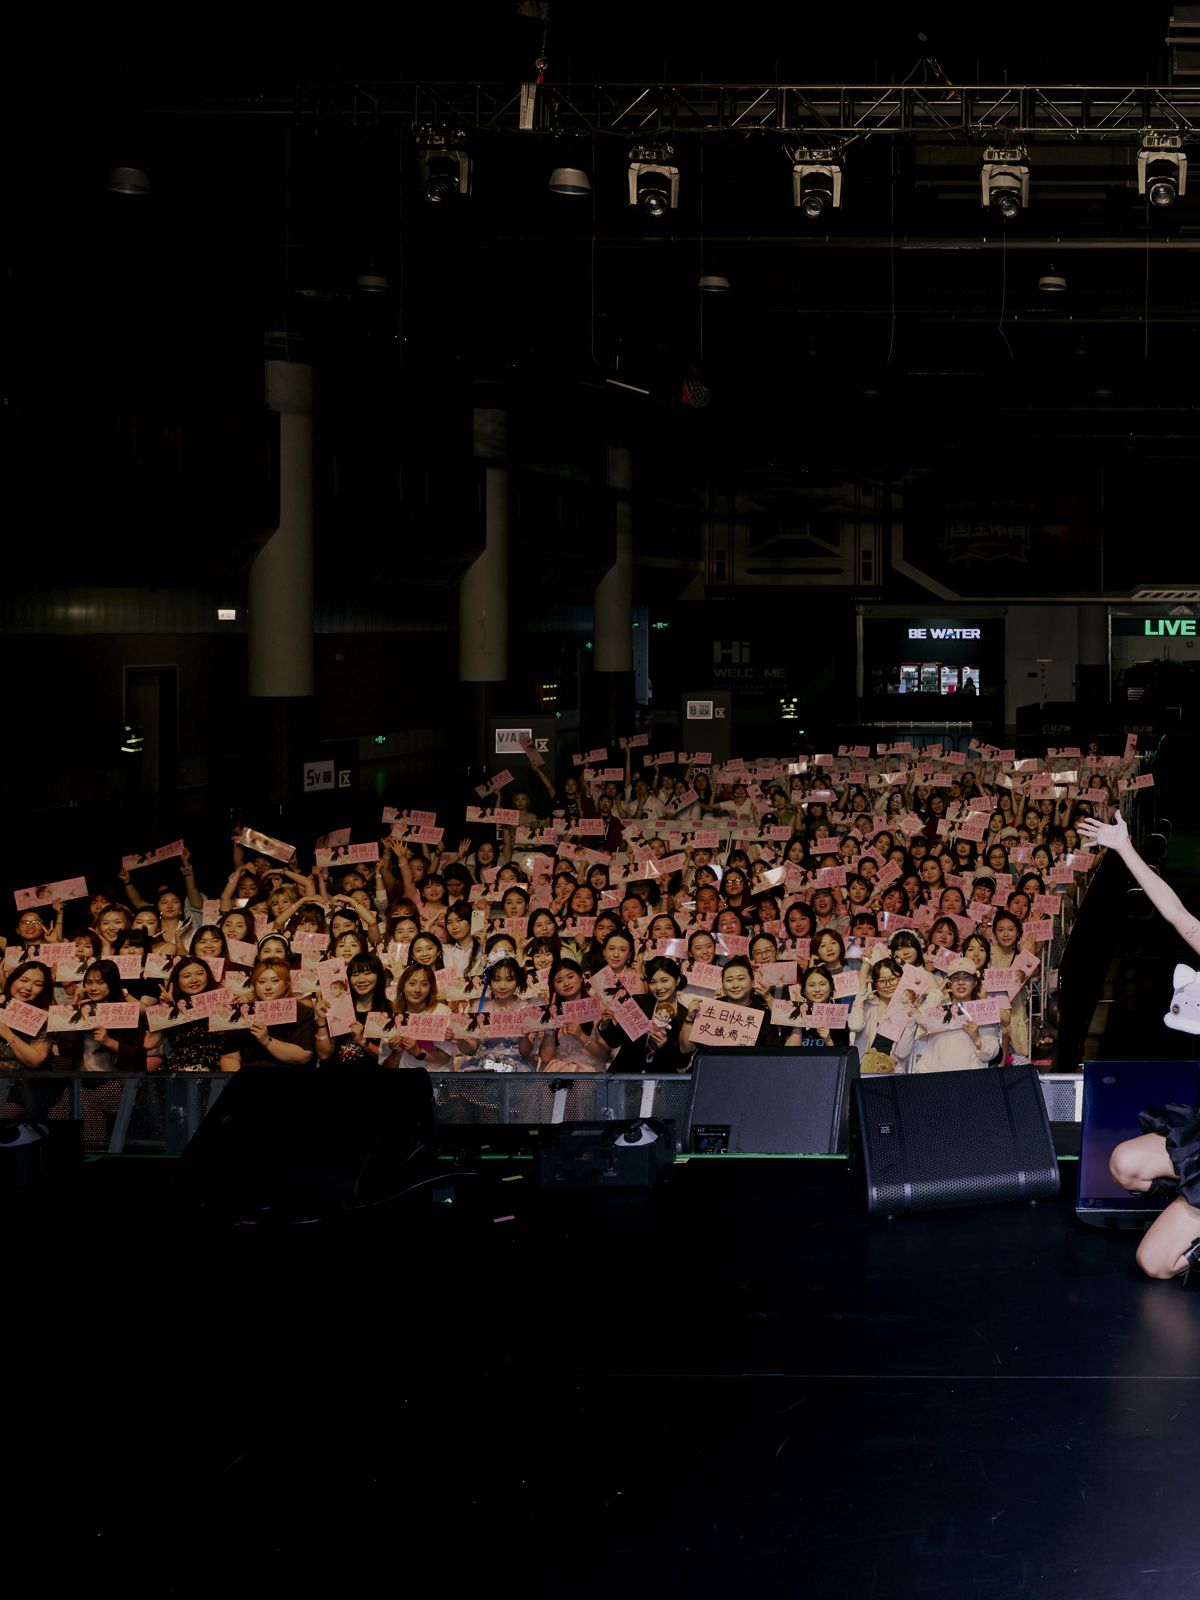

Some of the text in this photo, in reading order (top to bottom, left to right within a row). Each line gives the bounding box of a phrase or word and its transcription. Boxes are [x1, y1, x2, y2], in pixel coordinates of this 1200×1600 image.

[908, 628, 981, 639] BE WATER
[1145, 619, 1196, 636] LIVE
[713, 640, 751, 663] Hi
[713, 668, 785, 678] WELCME
